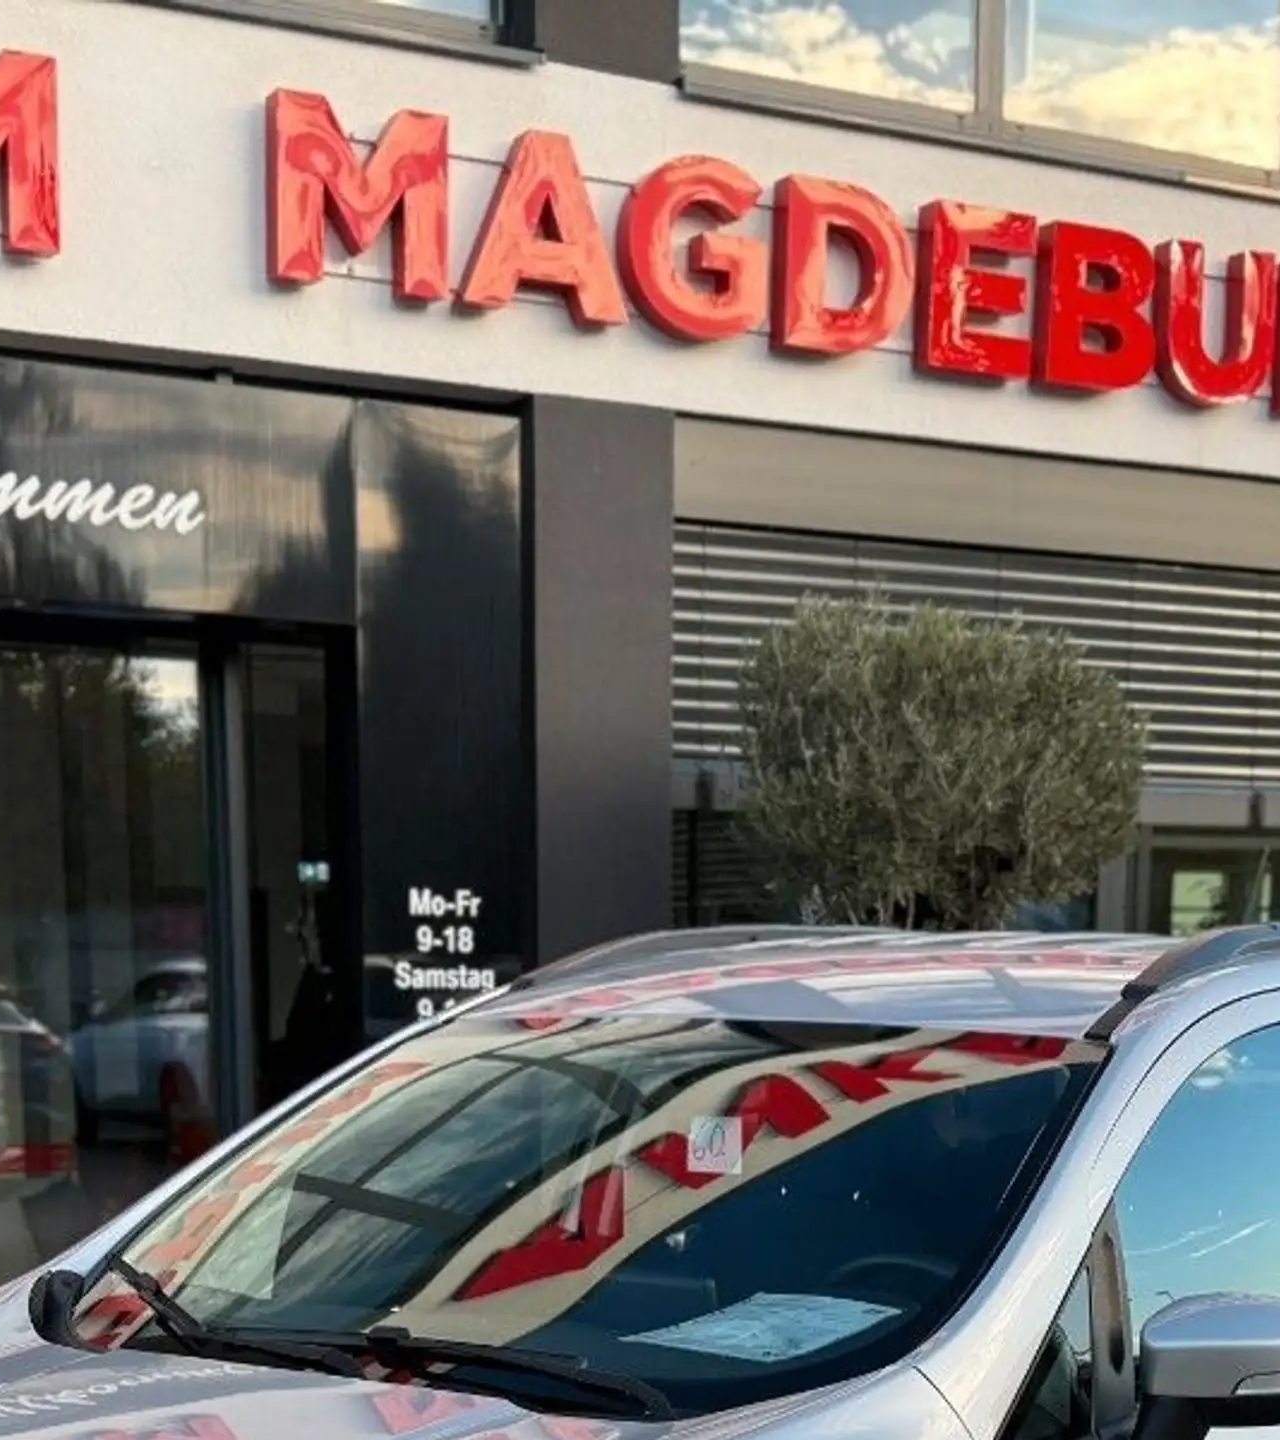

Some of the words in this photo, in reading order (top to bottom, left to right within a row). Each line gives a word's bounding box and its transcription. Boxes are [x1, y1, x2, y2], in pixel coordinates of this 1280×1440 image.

[408, 887, 481, 917] Mo-Fr
[416, 924, 474, 954] 9-18
[393, 960, 496, 991] Samstag
